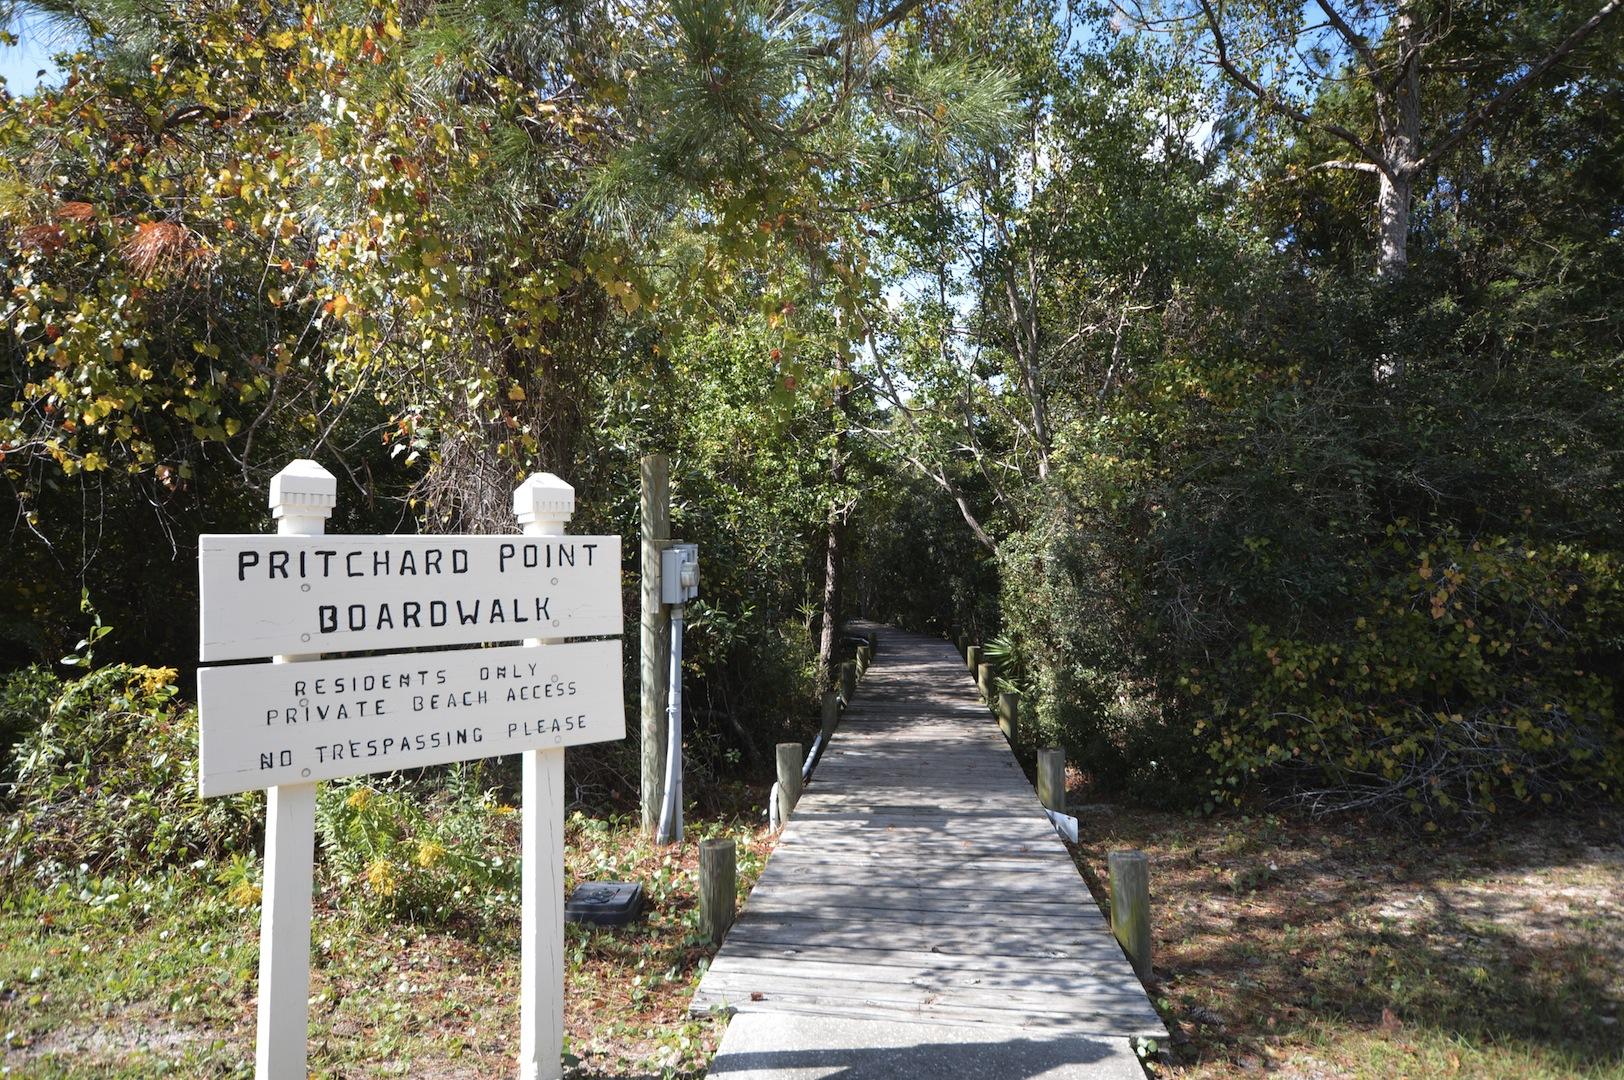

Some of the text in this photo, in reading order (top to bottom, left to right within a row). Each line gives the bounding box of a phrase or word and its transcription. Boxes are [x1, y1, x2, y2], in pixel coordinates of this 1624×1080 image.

[238, 543, 598, 581] PRITCHARD POINT
[319, 597, 551, 634] BOARDWALK
[295, 663, 538, 697] RESIDENTS ONLY
[266, 681, 577, 726] PRIVATE BEACH ACCESS
[260, 714, 587, 770] NO TRESPASSING PLEASE
